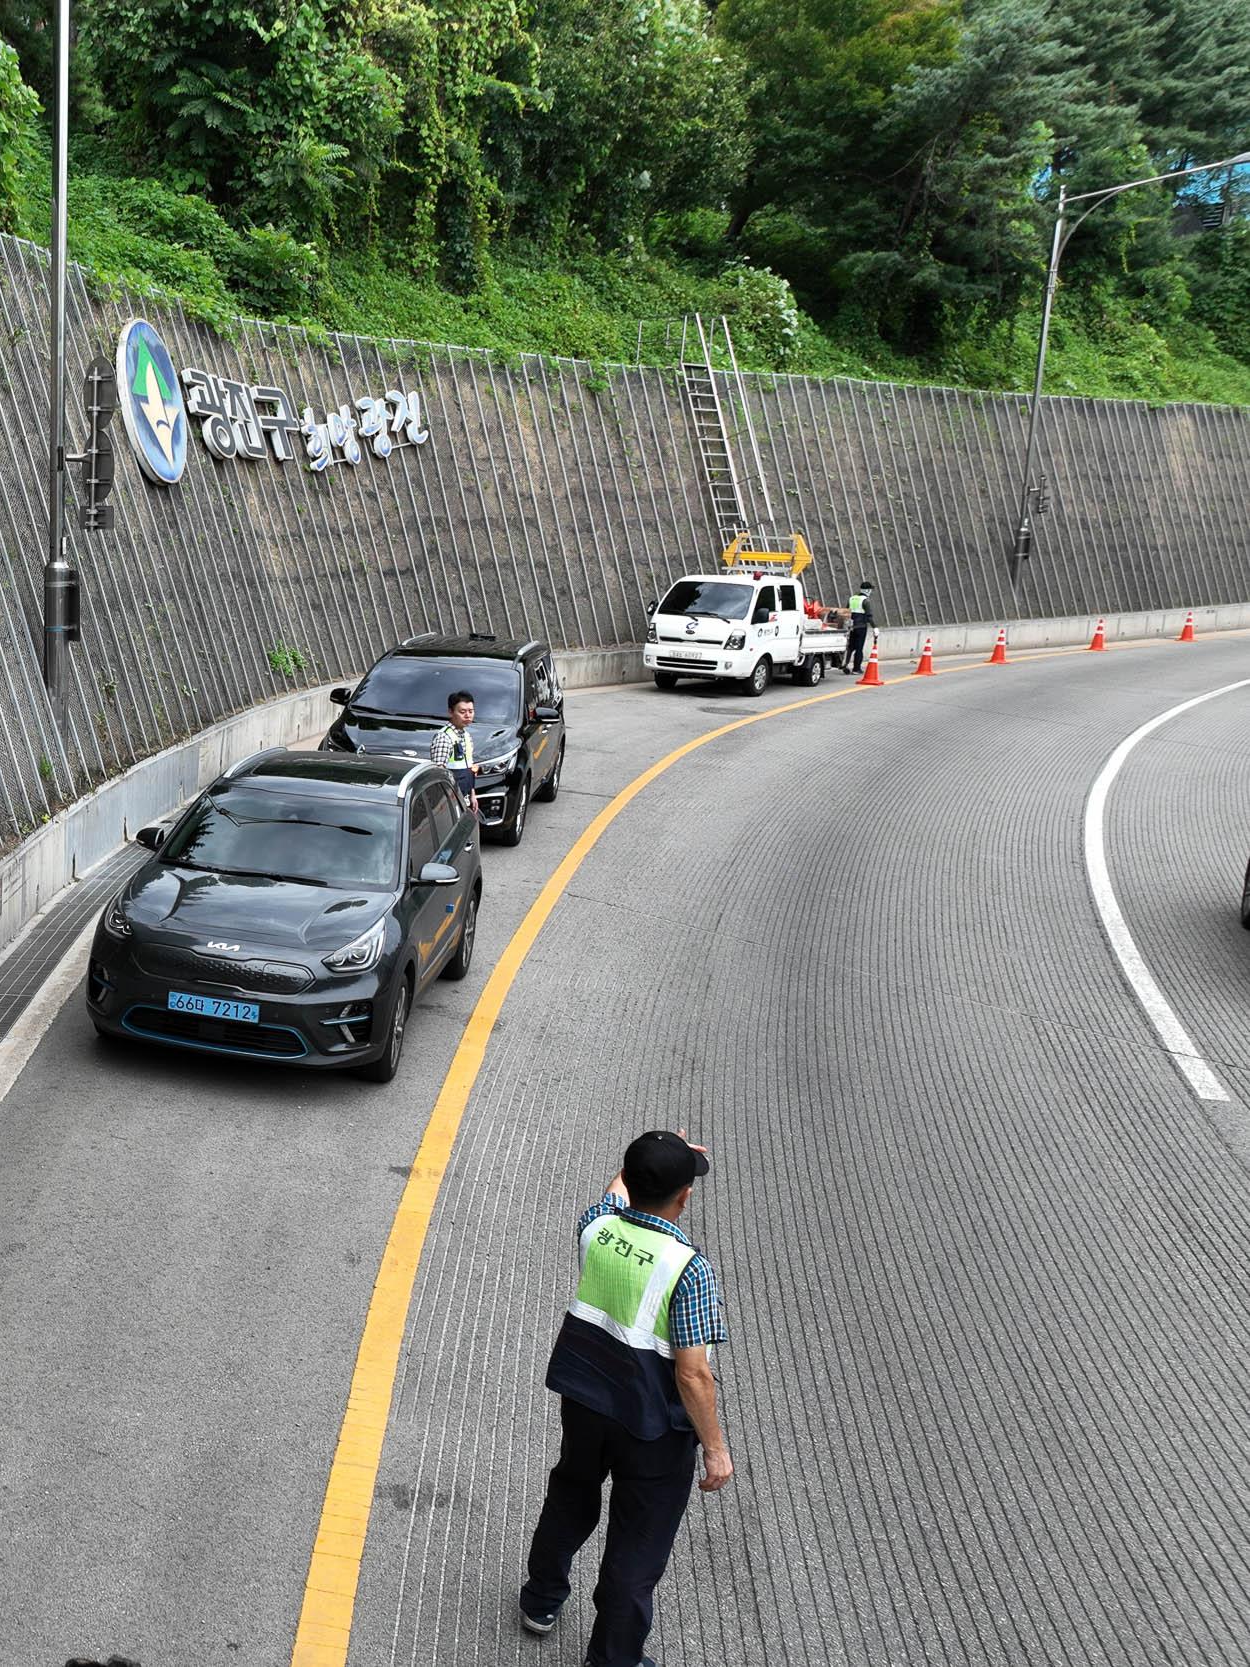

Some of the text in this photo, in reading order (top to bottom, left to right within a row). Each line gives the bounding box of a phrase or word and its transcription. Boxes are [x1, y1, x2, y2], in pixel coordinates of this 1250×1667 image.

[181, 368, 299, 461] 광진구
[212, 1000, 251, 1020] 7212
[596, 1227, 654, 1266] 광진구
